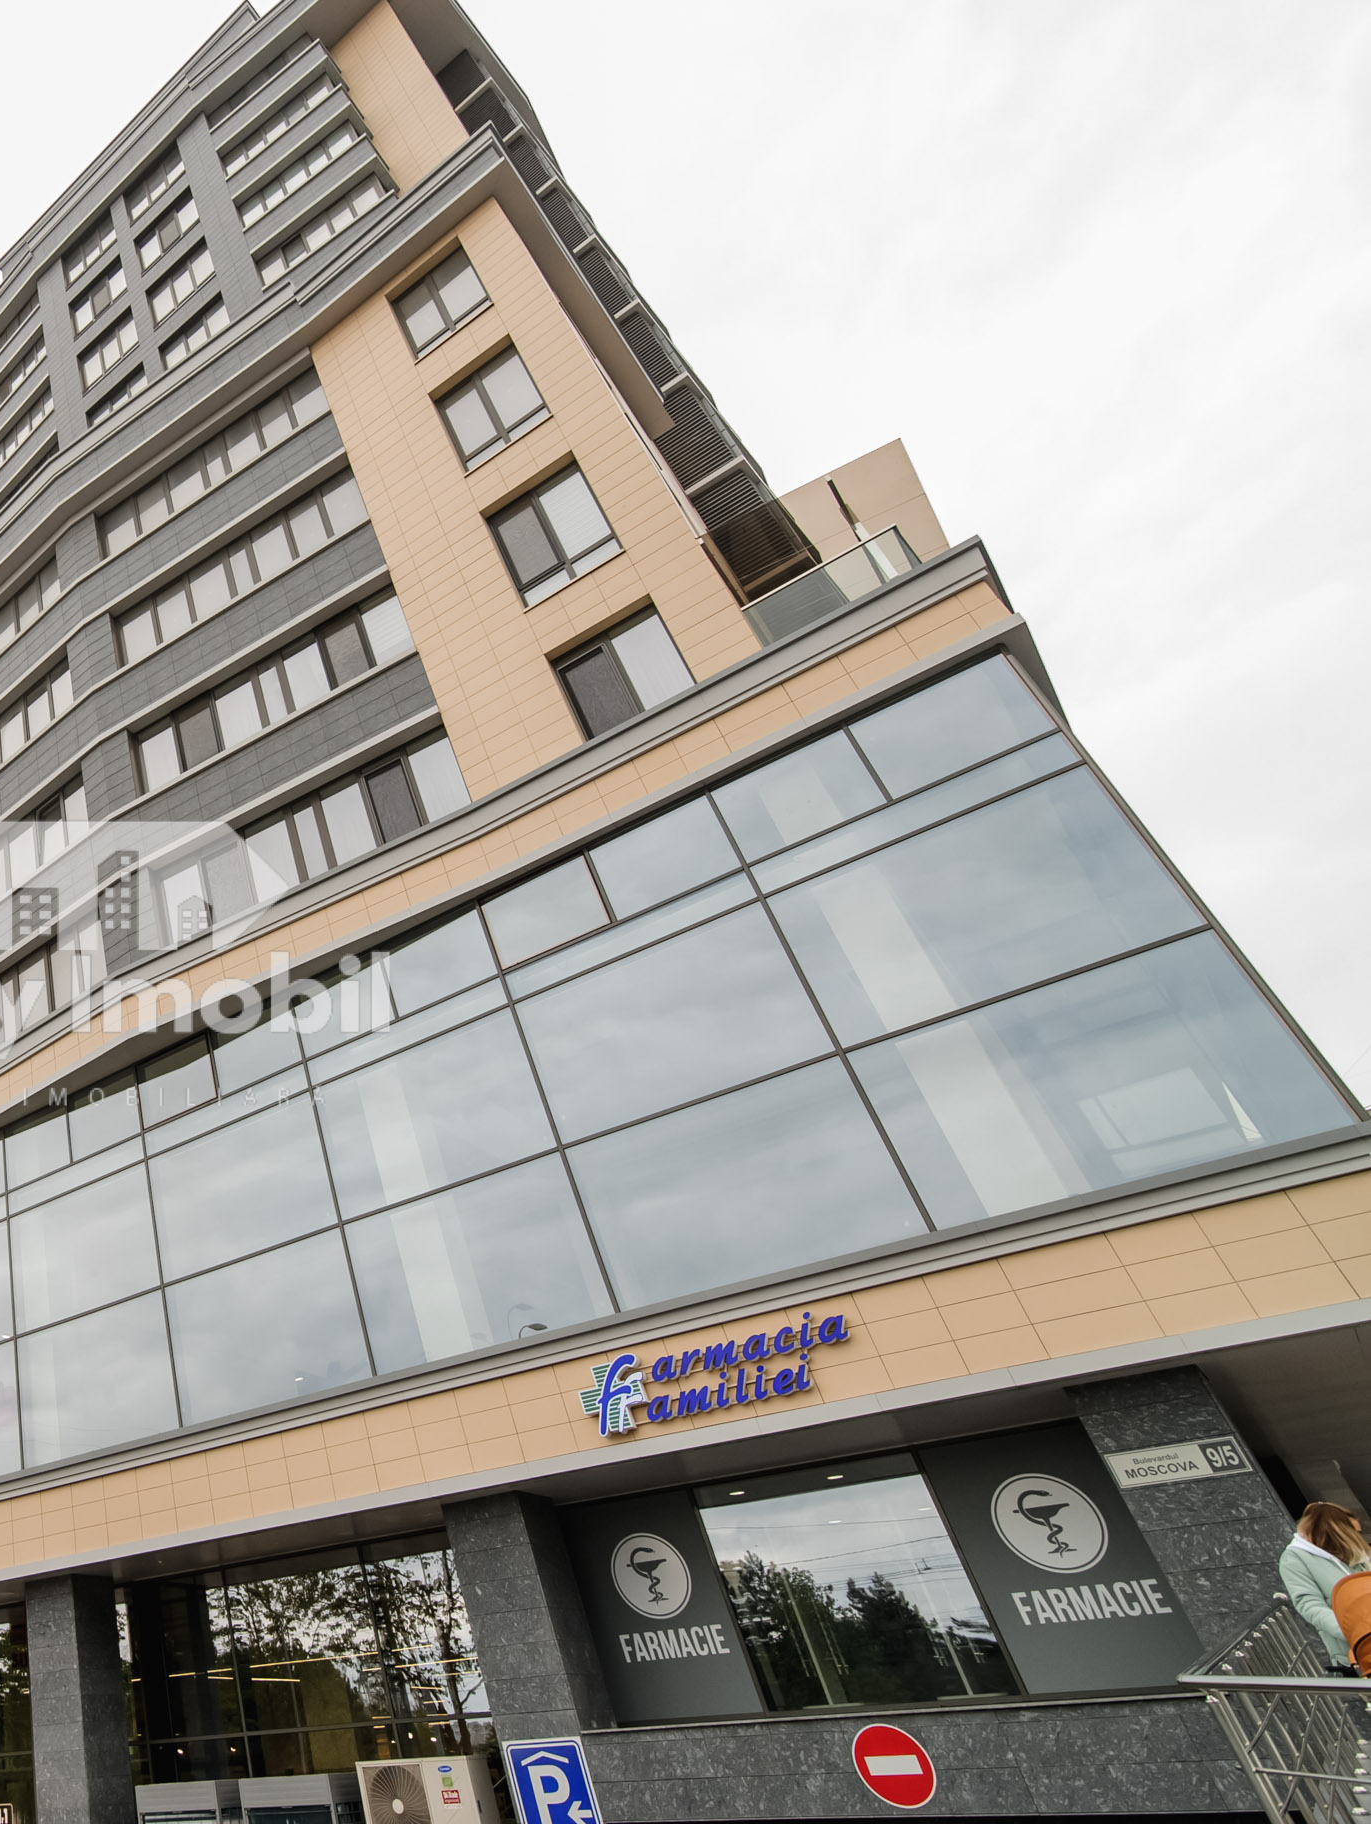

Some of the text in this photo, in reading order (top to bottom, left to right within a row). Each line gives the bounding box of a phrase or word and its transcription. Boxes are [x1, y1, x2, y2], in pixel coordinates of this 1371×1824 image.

[1124, 1445, 1240, 1480] MOSCOVA 9/5
[1132, 1452, 1179, 1465] Bulevardul
[1010, 1578, 1174, 1627] FARMACIE
[618, 1623, 731, 1664] FARMACIE
[527, 1764, 571, 1824] P
